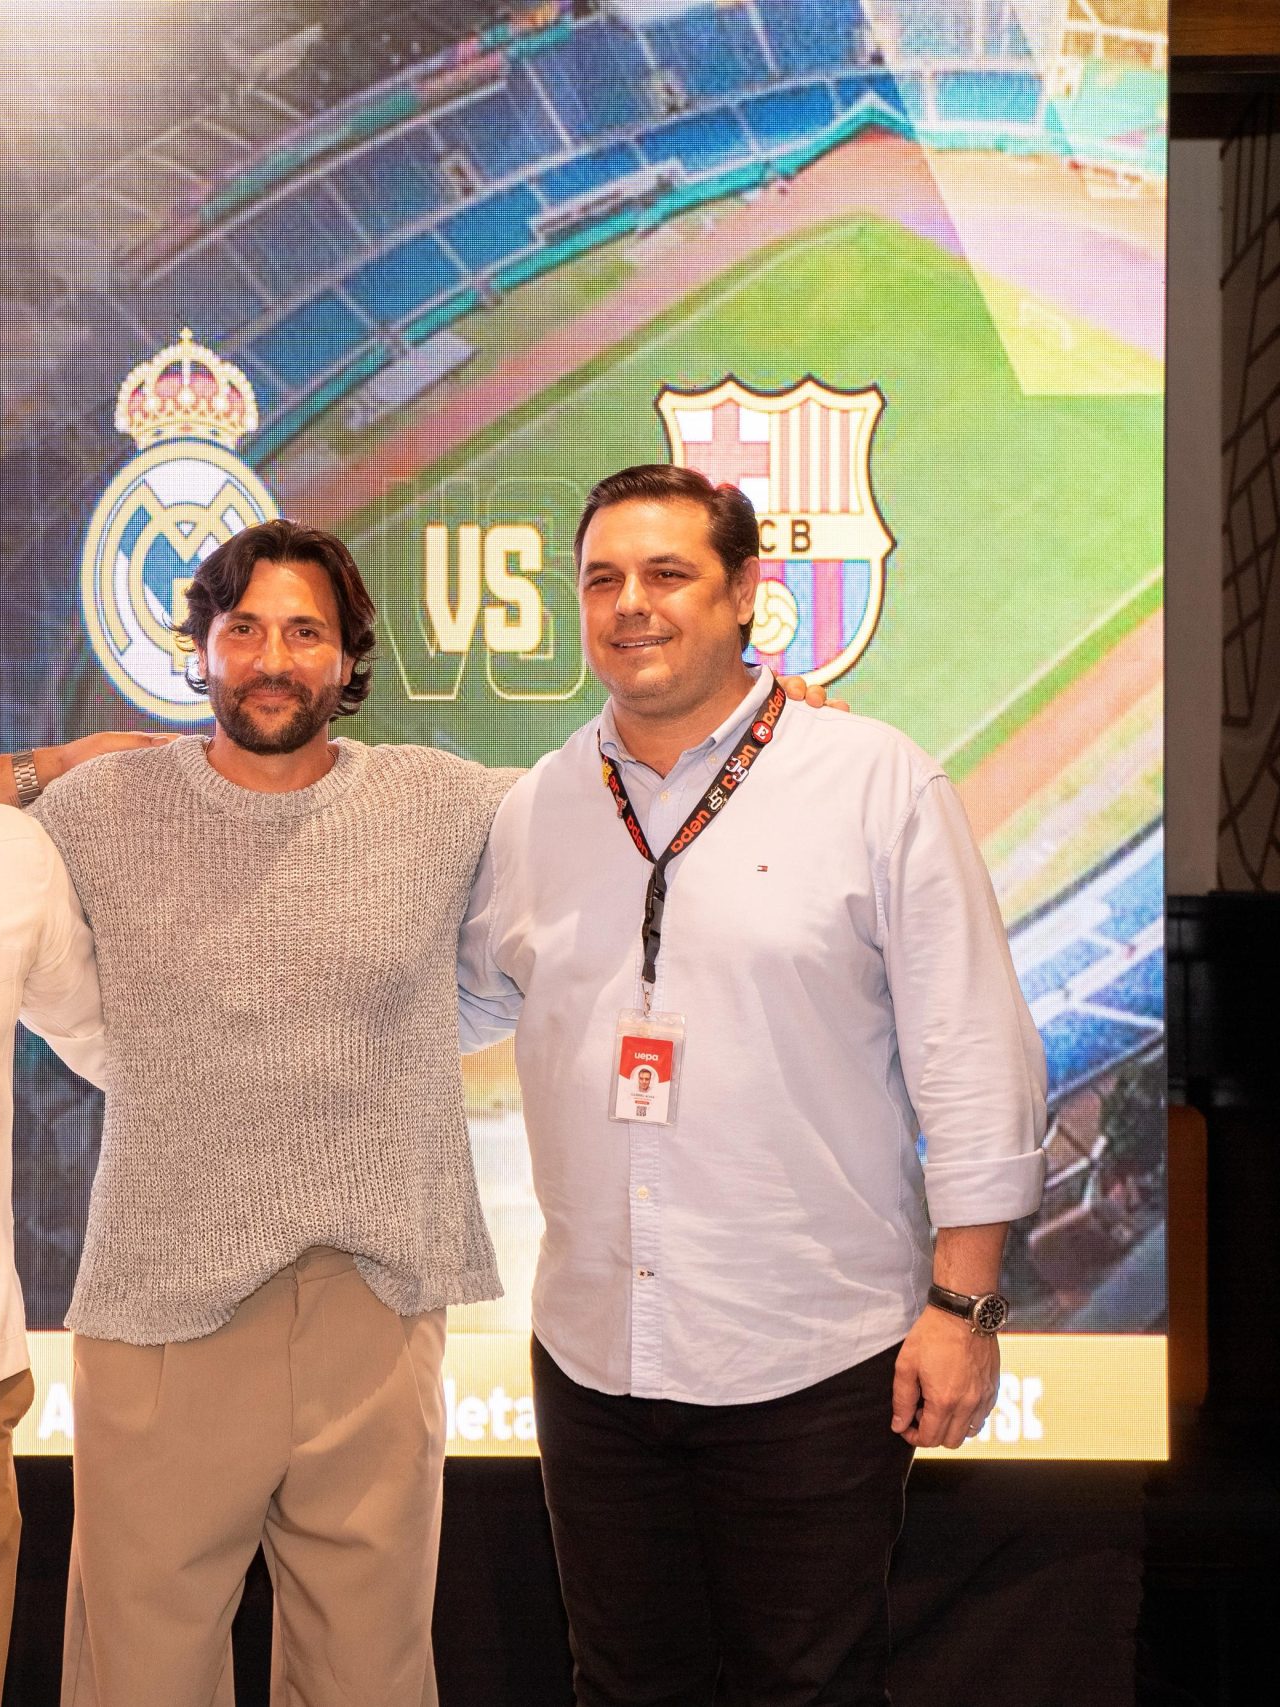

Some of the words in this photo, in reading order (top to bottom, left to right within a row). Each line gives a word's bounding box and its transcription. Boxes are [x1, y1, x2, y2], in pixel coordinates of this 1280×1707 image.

[759, 519, 811, 553] CB
[423, 521, 547, 655] VS
[721, 744, 758, 790] uea
[669, 809, 711, 854] uepa
[634, 1051, 659, 1062] uepa
